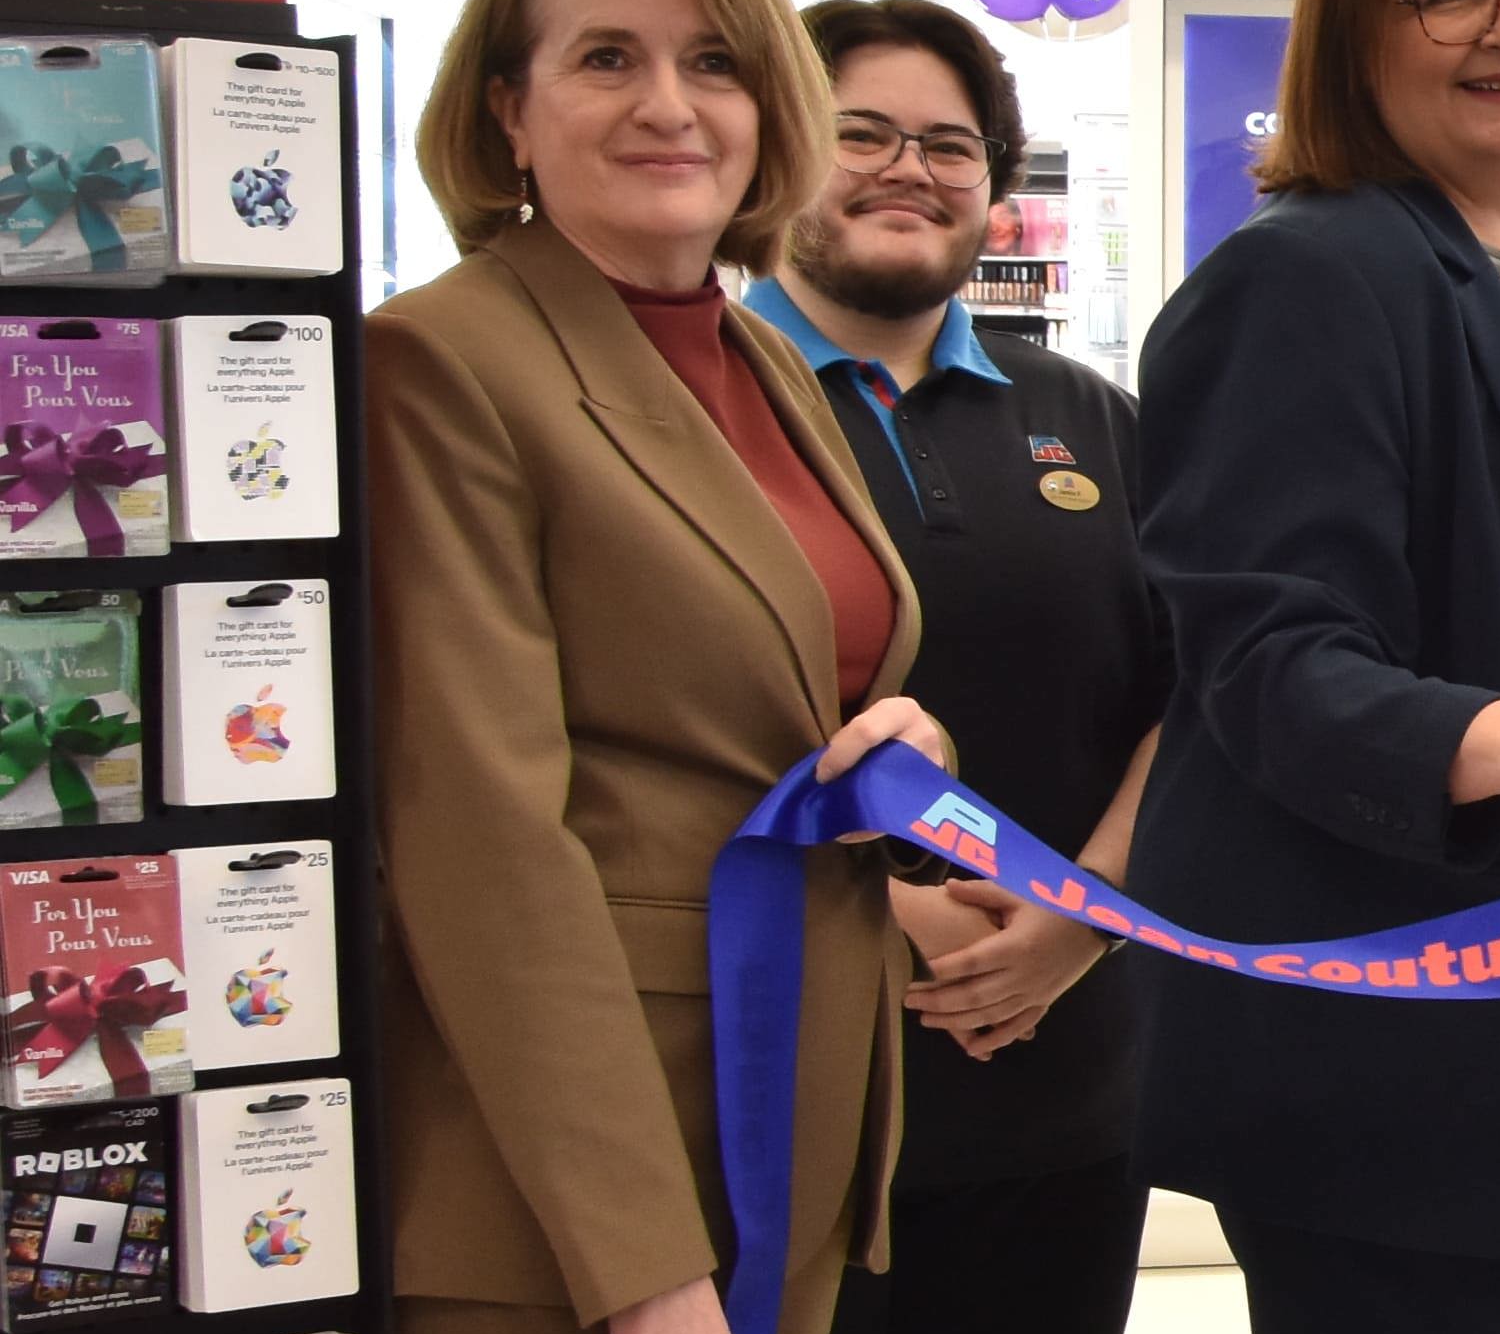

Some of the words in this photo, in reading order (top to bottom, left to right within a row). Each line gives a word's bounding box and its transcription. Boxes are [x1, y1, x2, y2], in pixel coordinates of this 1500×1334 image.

[288, 327, 323, 342] $100
[11, 354, 47, 377] For
[51, 354, 99, 391] You
[217, 368, 266, 377] everything
[269, 368, 295, 376] Apple
[220, 356, 237, 365] The
[240, 356, 255, 366] gift
[257, 356, 277, 365] card
[279, 356, 291, 365] for
[24, 385, 76, 408] Pour
[81, 385, 133, 407] Vous
[10, 870, 50, 885] VISA
[136, 862, 159, 874] $25
[32, 900, 67, 924] For
[72, 898, 119, 934] You
[1028, 875, 1237, 970] Jean
[48, 930, 97, 954] Pour
[102, 926, 153, 948] Vous
[320, 1092, 347, 1106] $25
[15, 1141, 148, 1177] ROBLOX
